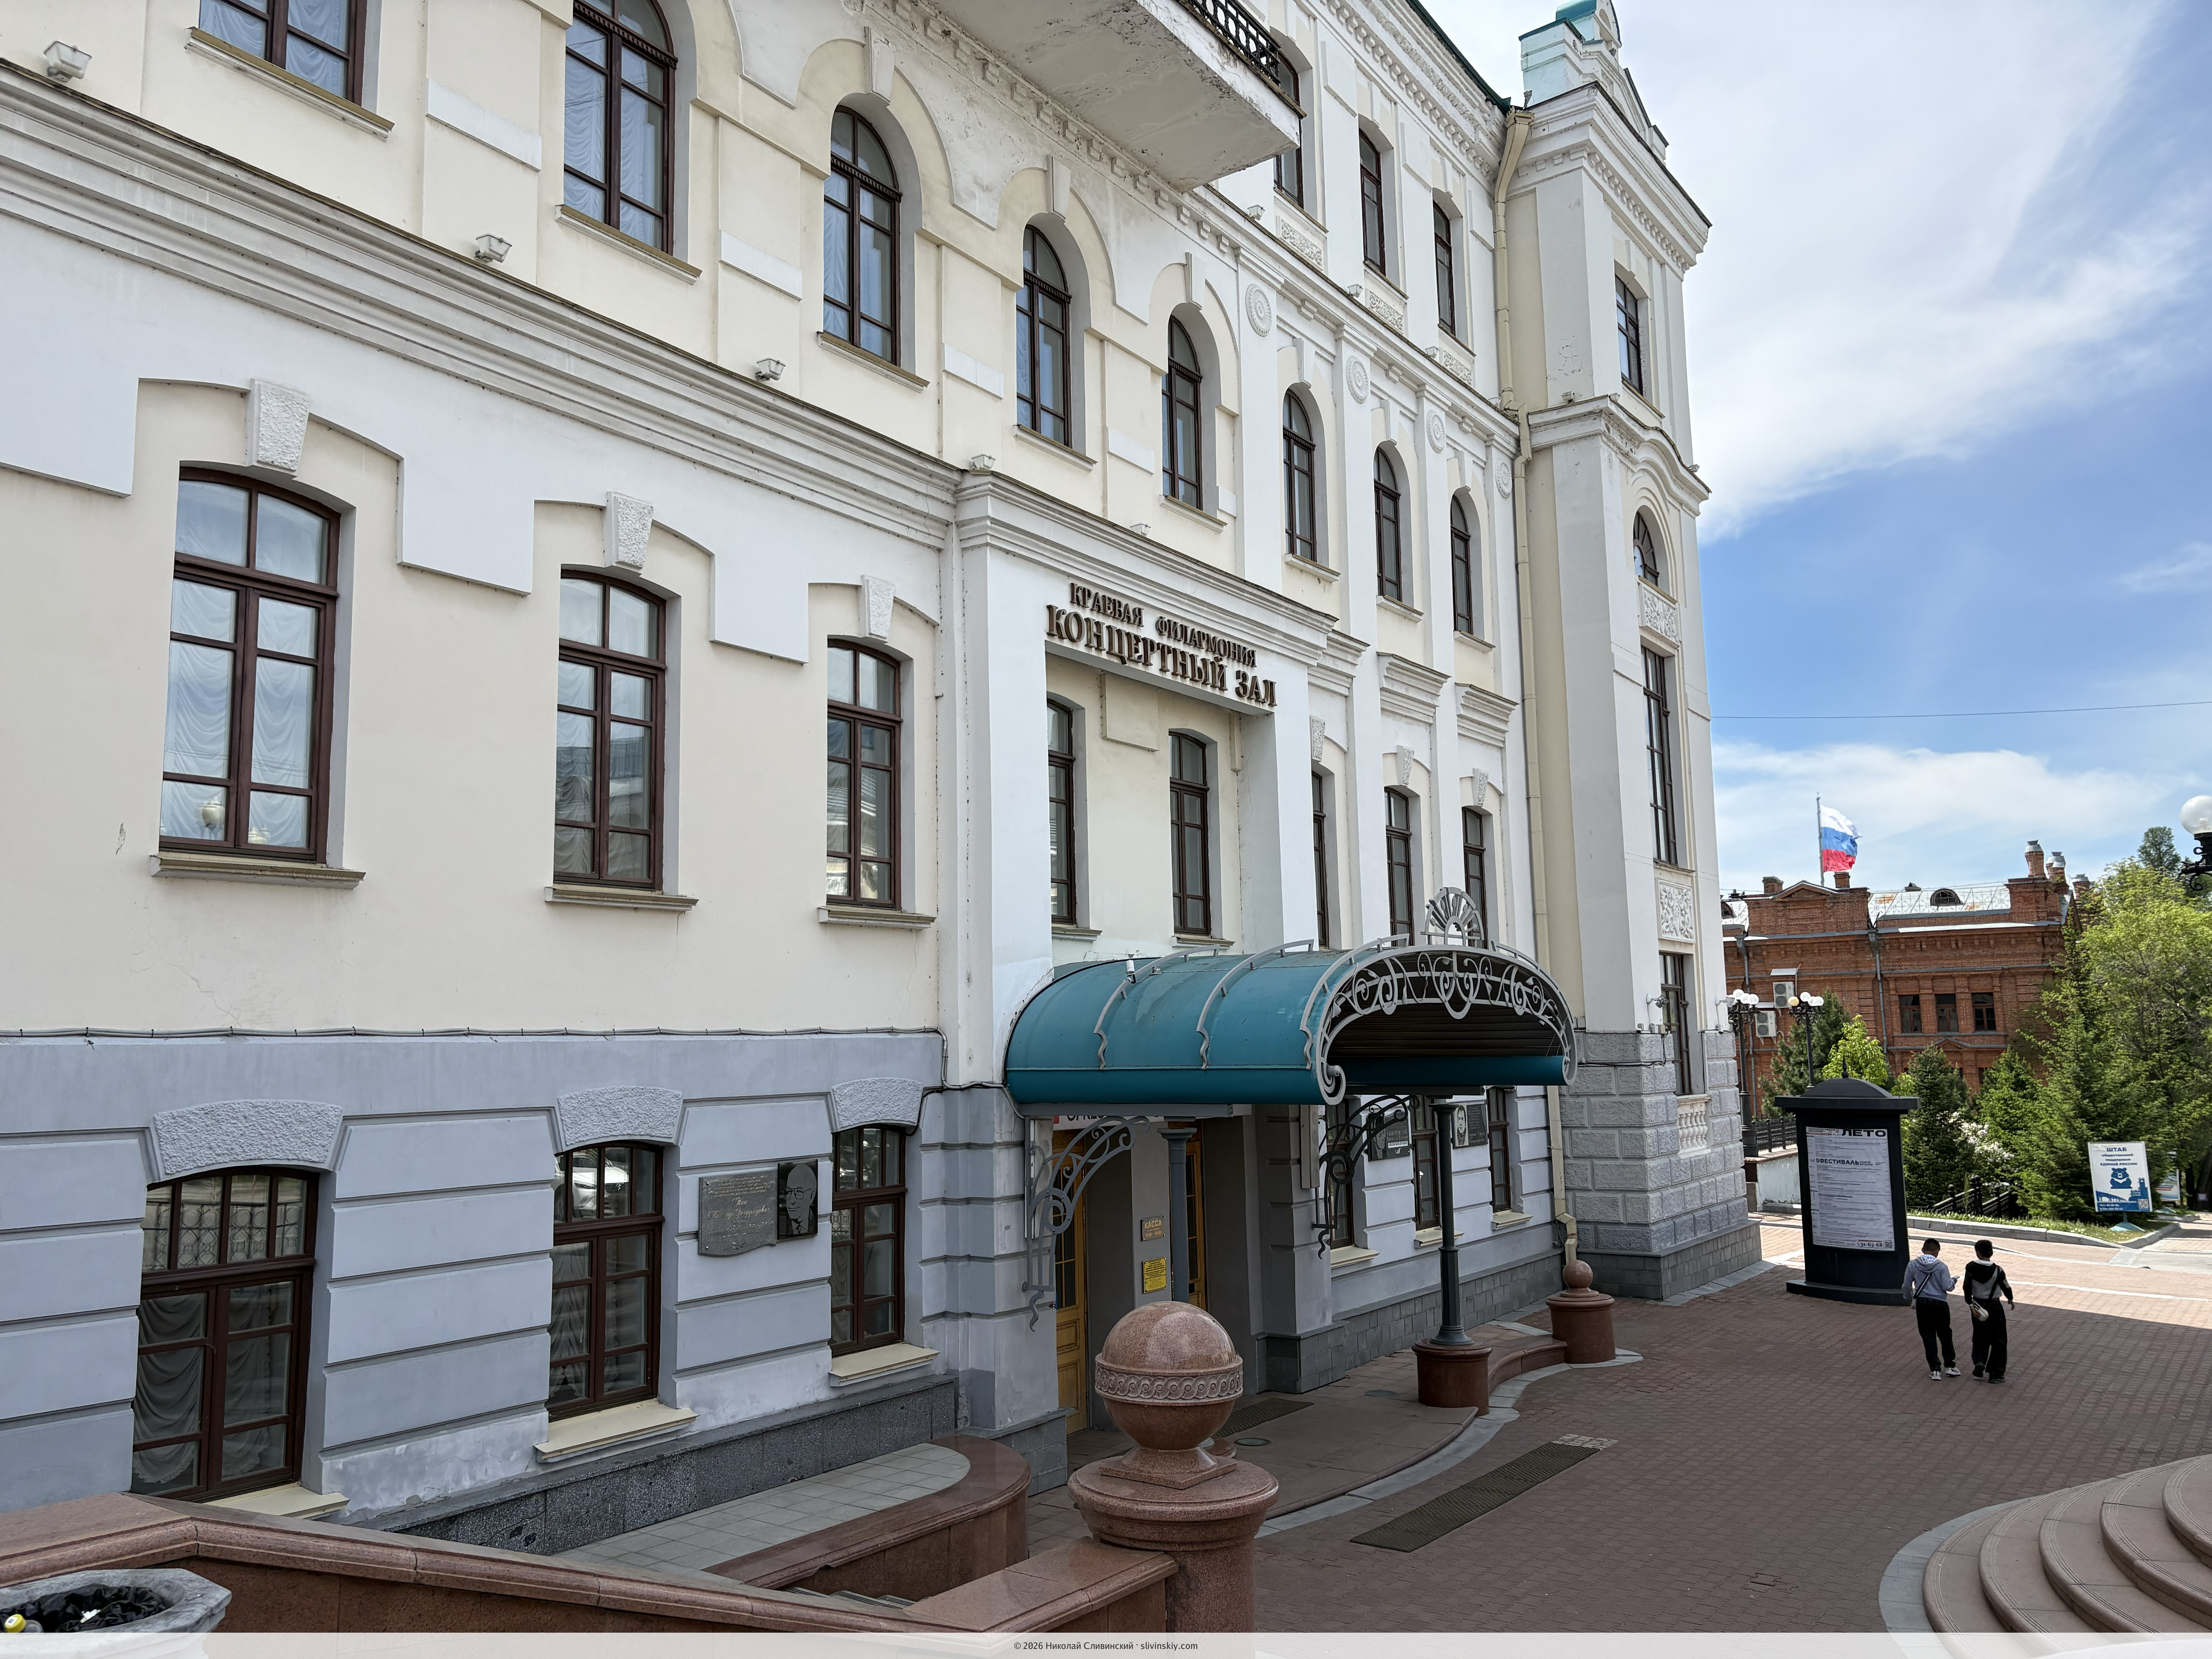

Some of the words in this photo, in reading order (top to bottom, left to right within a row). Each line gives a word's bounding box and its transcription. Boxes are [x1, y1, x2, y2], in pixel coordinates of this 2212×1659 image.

[1070, 582, 1144, 627] КРАЕВАЯ
[1155, 616, 1257, 667] ФИЛАРМОНИЯ
[1046, 605, 1228, 691] КОНЦЕРТНЫЙ
[1235, 670, 1277, 707] ЗАЛ
[1842, 1129, 1886, 1137] ЛЕТО
[1144, 1219, 1162, 1229] КАССА
